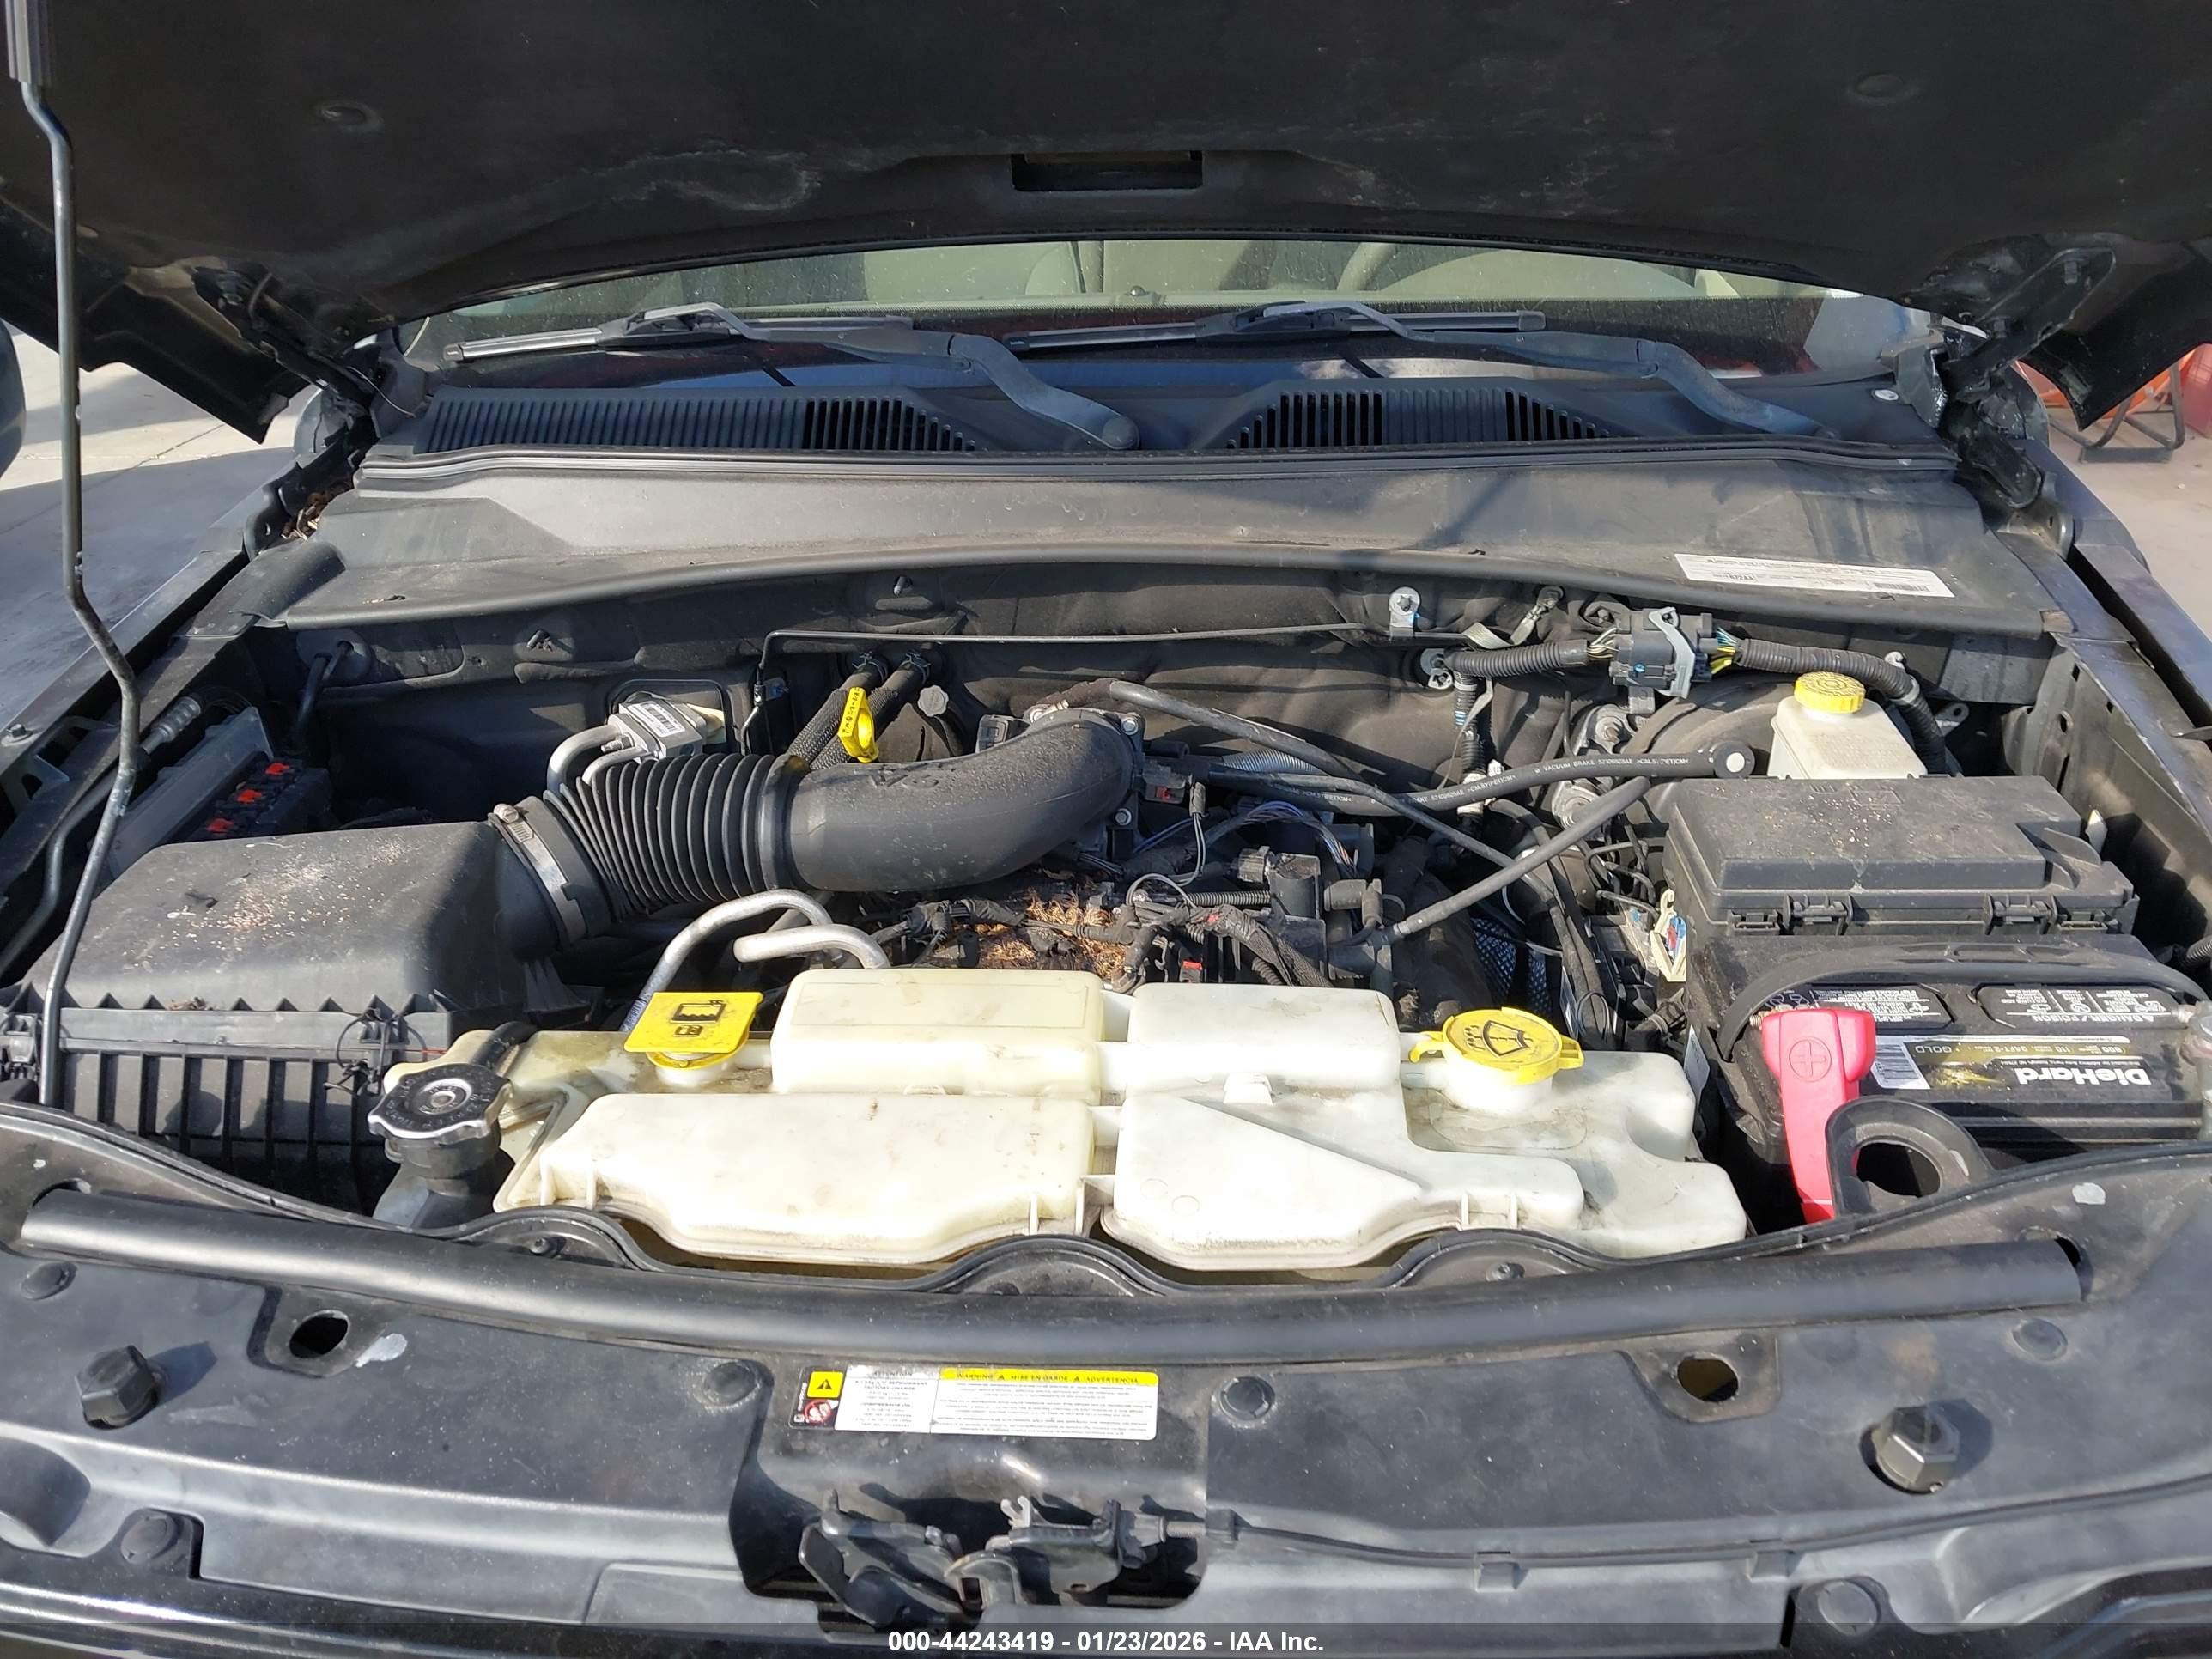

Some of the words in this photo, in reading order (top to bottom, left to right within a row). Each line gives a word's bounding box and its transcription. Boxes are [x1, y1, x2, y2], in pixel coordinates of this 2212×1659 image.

[1543, 763, 1571, 771] VACUUM
[2032, 1014, 2080, 1023] POISON
[1915, 1045, 1952, 1054] GOLD
[2014, 1068, 2152, 1085] DieHard
